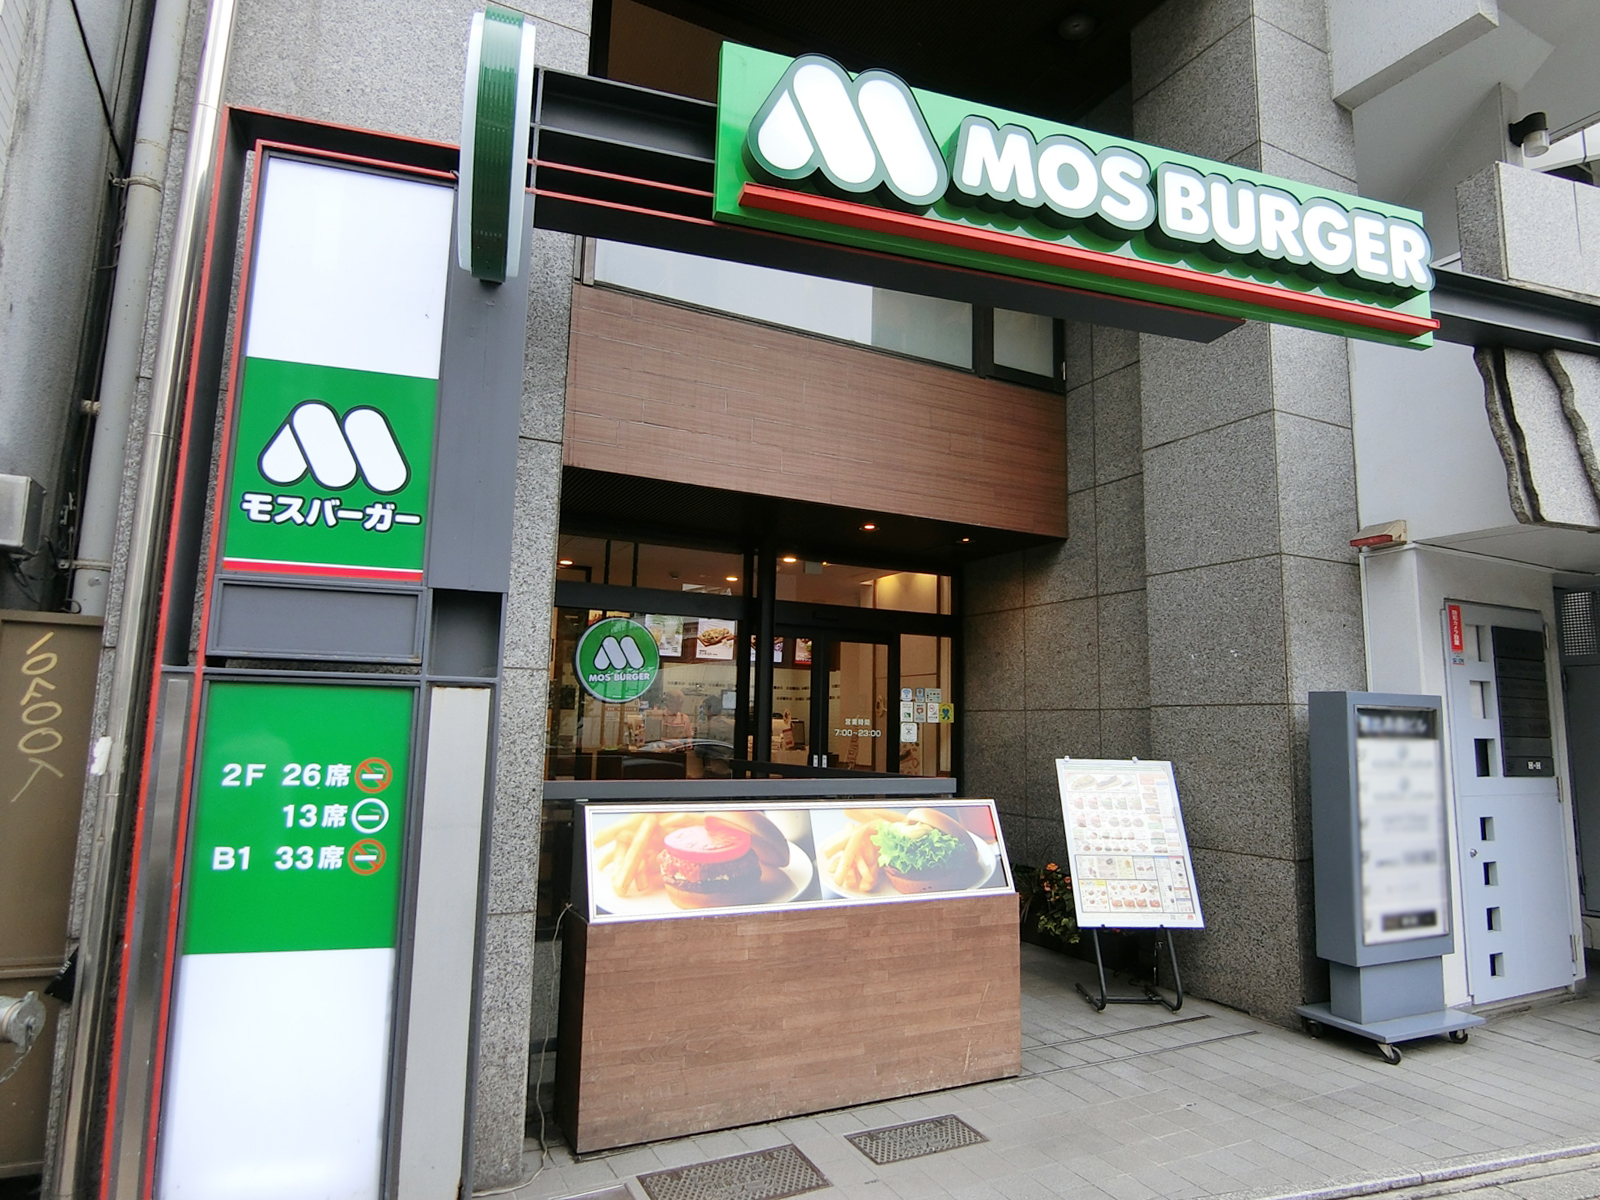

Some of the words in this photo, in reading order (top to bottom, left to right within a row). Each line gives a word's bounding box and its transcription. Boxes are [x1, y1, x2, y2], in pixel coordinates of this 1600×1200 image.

[961, 123, 1149, 222] MOS
[1163, 170, 1428, 285] BURGER
[240, 492, 421, 532] モスバーガー
[588, 673, 611, 682] MOS
[613, 672, 651, 682] BURGER
[221, 763, 267, 787] 2F
[281, 763, 352, 788] 26席
[282, 804, 349, 829] 13席
[212, 846, 251, 871] B1
[274, 845, 345, 870] 33席
